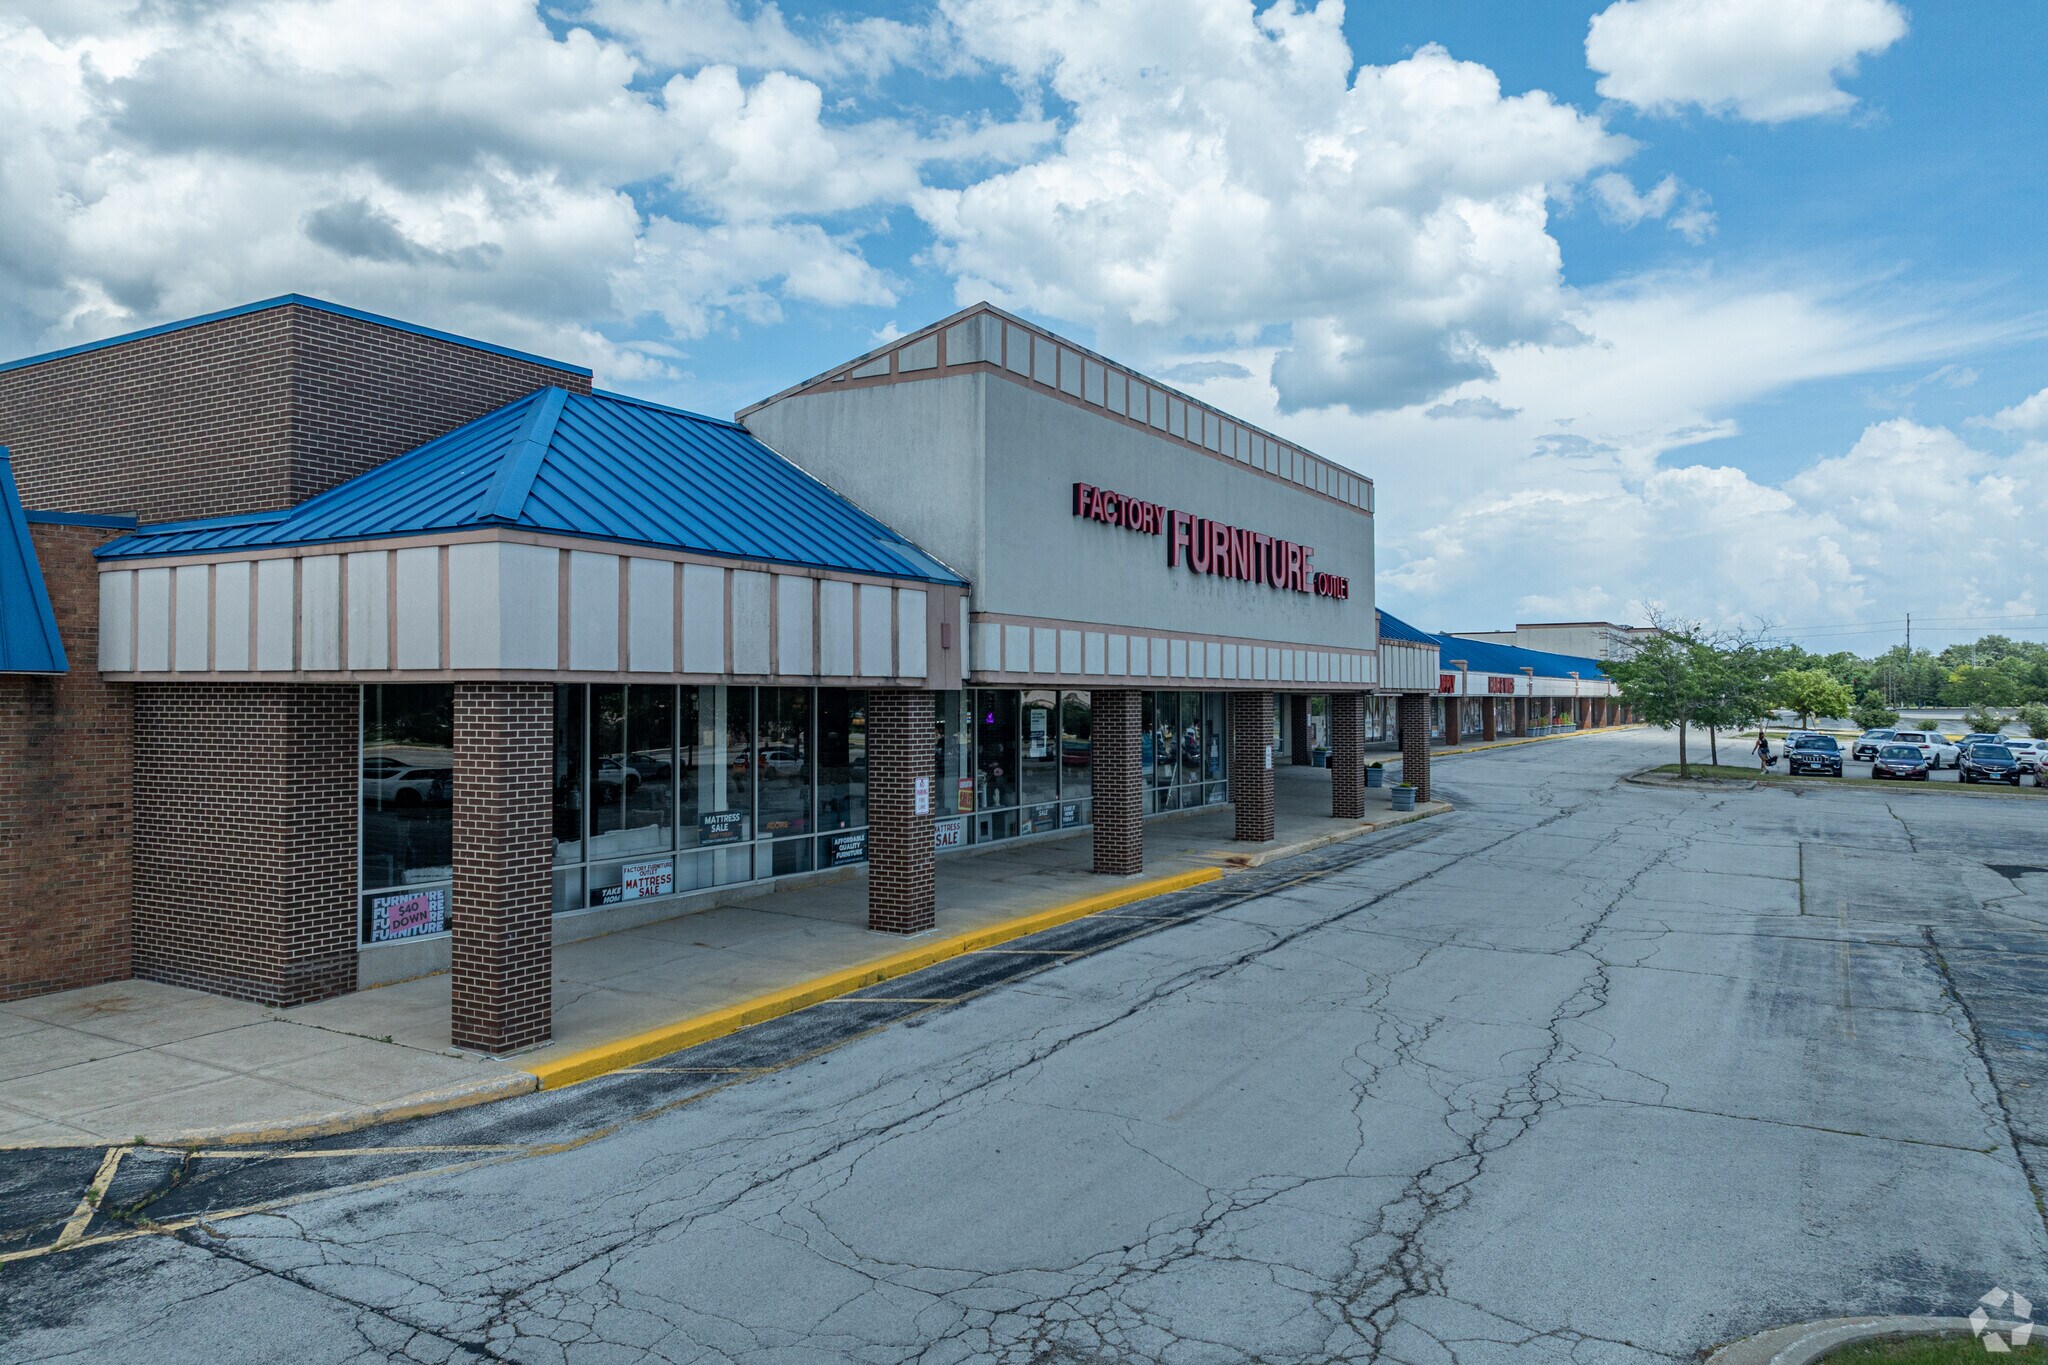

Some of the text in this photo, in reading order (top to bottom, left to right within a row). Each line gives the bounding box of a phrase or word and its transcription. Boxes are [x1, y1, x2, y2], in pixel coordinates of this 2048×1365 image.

[1073, 482, 1349, 599] FACTORY FURNITURE OUTLET
[704, 813, 741, 825] MATTRESS
[711, 823, 729, 833] SALE
[834, 834, 865, 846] AFFORDABLE
[936, 832, 958, 847] SALE
[838, 842, 861, 851] QUALITY
[836, 848, 863, 859] FURNITURE
[623, 865, 647, 874] FACTORY
[639, 868, 658, 877] OUTLET
[625, 874, 672, 890] MATTRESS
[602, 886, 622, 897] TAKE
[638, 885, 660, 897] SALE
[398, 902, 419, 917] $40
[392, 910, 428, 930] DOWN
[371, 920, 444, 942] FURNITURE
